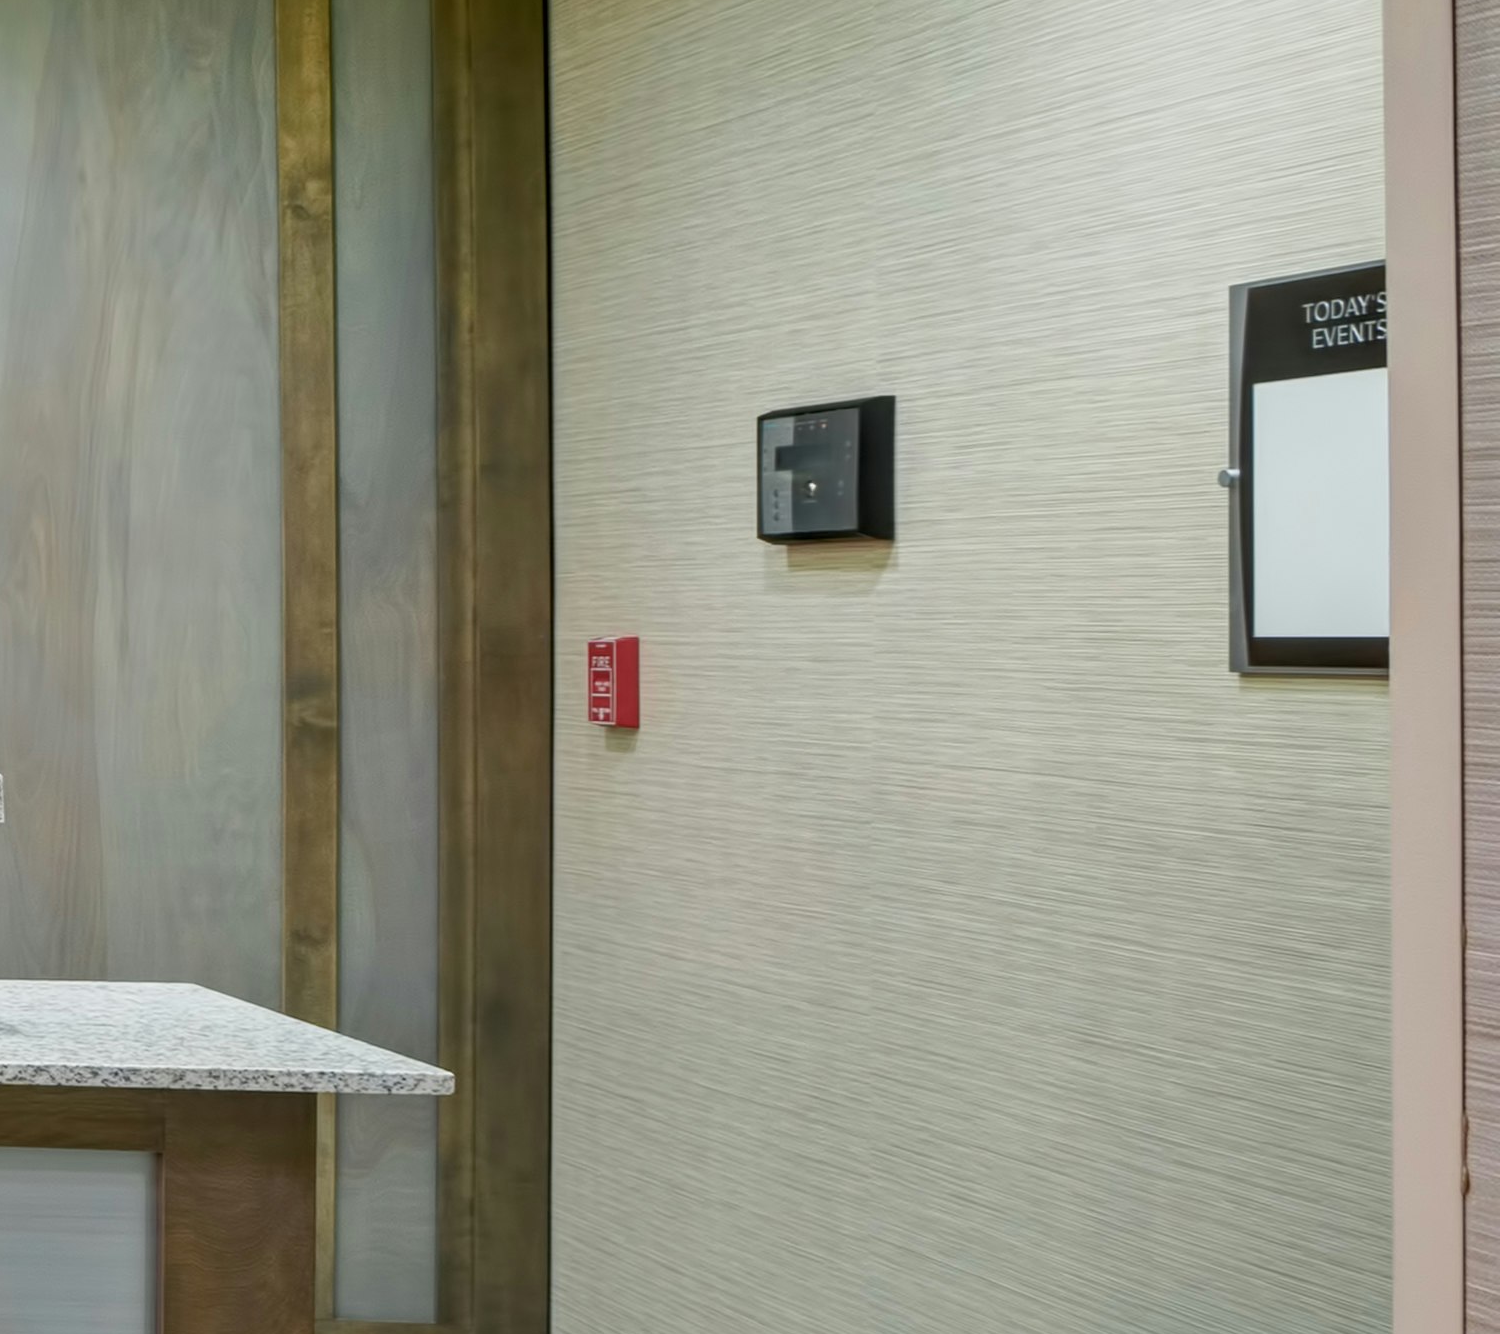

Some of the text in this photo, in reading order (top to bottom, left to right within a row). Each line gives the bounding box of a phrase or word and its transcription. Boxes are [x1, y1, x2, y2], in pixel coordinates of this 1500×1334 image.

[1301, 291, 1387, 323] TODAY'S
[1312, 318, 1387, 349] EVENTS
[592, 656, 611, 668] FIRE
